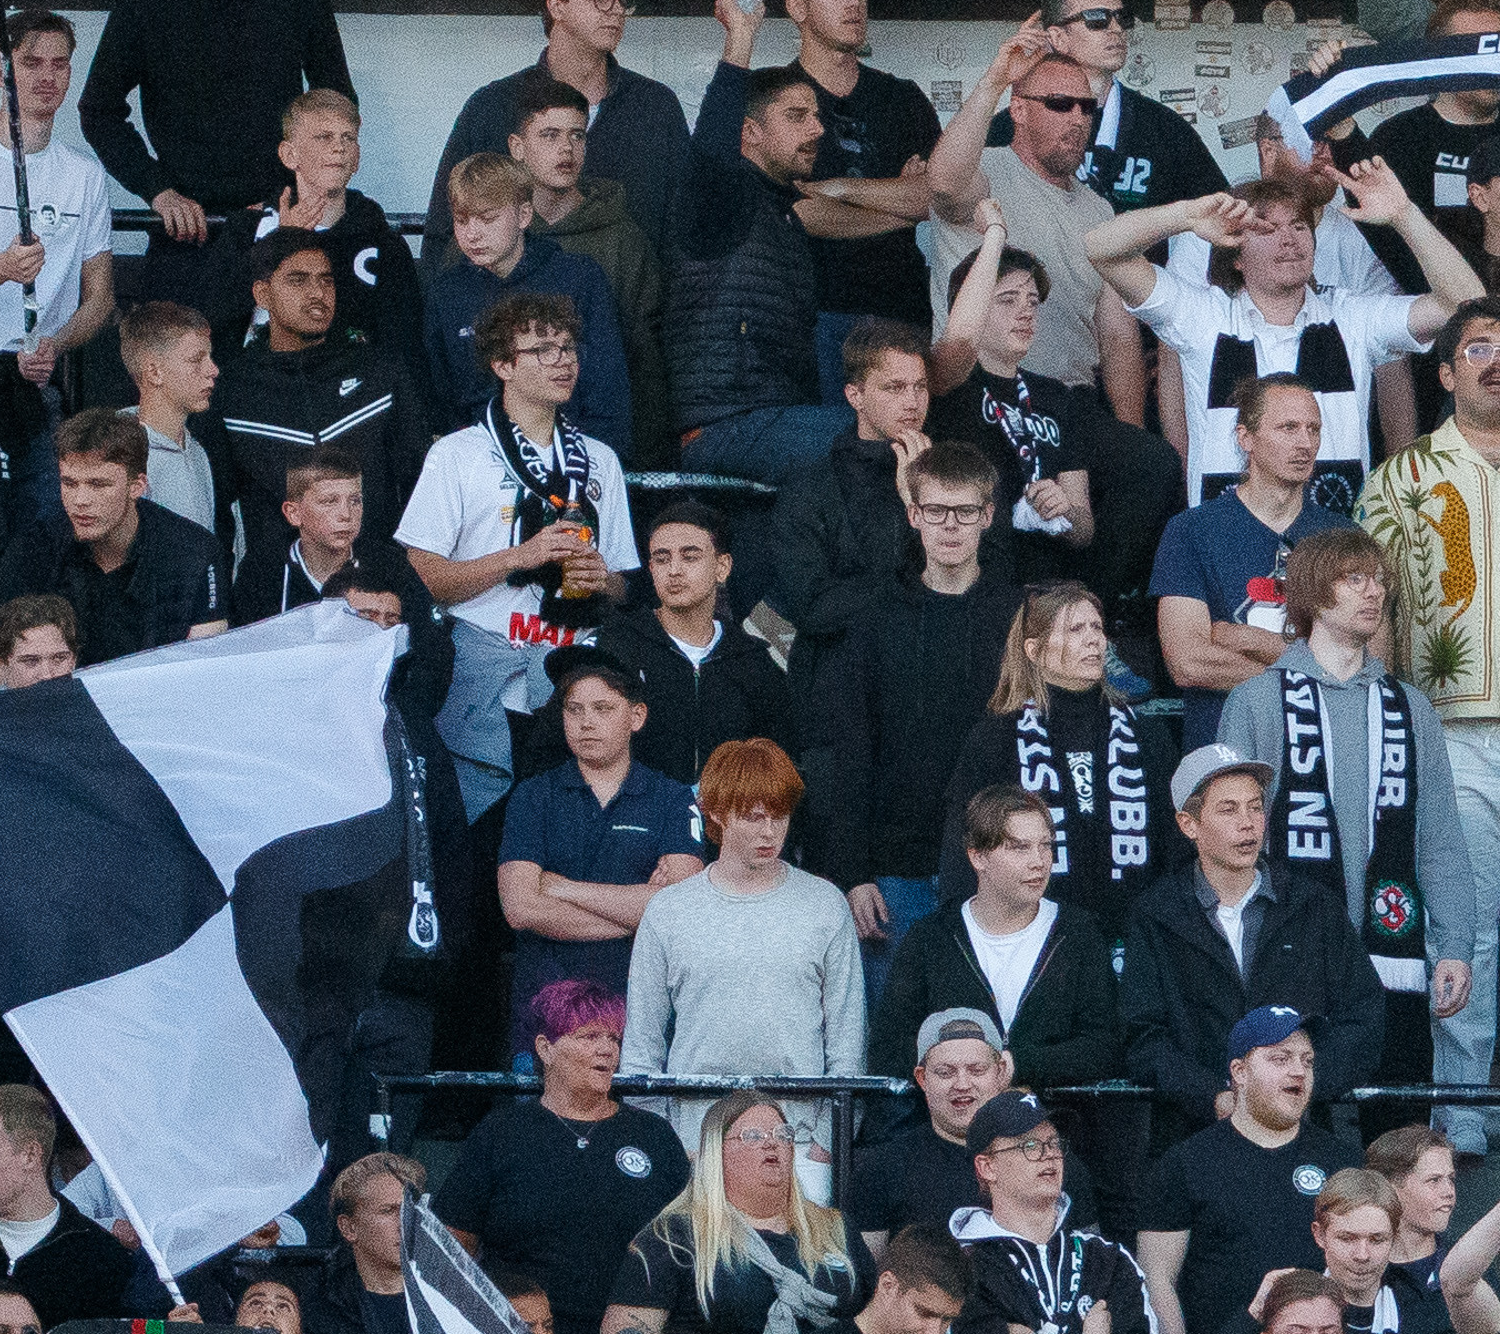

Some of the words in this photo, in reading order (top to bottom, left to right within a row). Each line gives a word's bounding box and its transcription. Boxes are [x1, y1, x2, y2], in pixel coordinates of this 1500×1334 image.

[1016, 701, 1060, 792] STA
[1108, 705, 1149, 880] KLUBB.
[1287, 789, 1333, 860] EN
